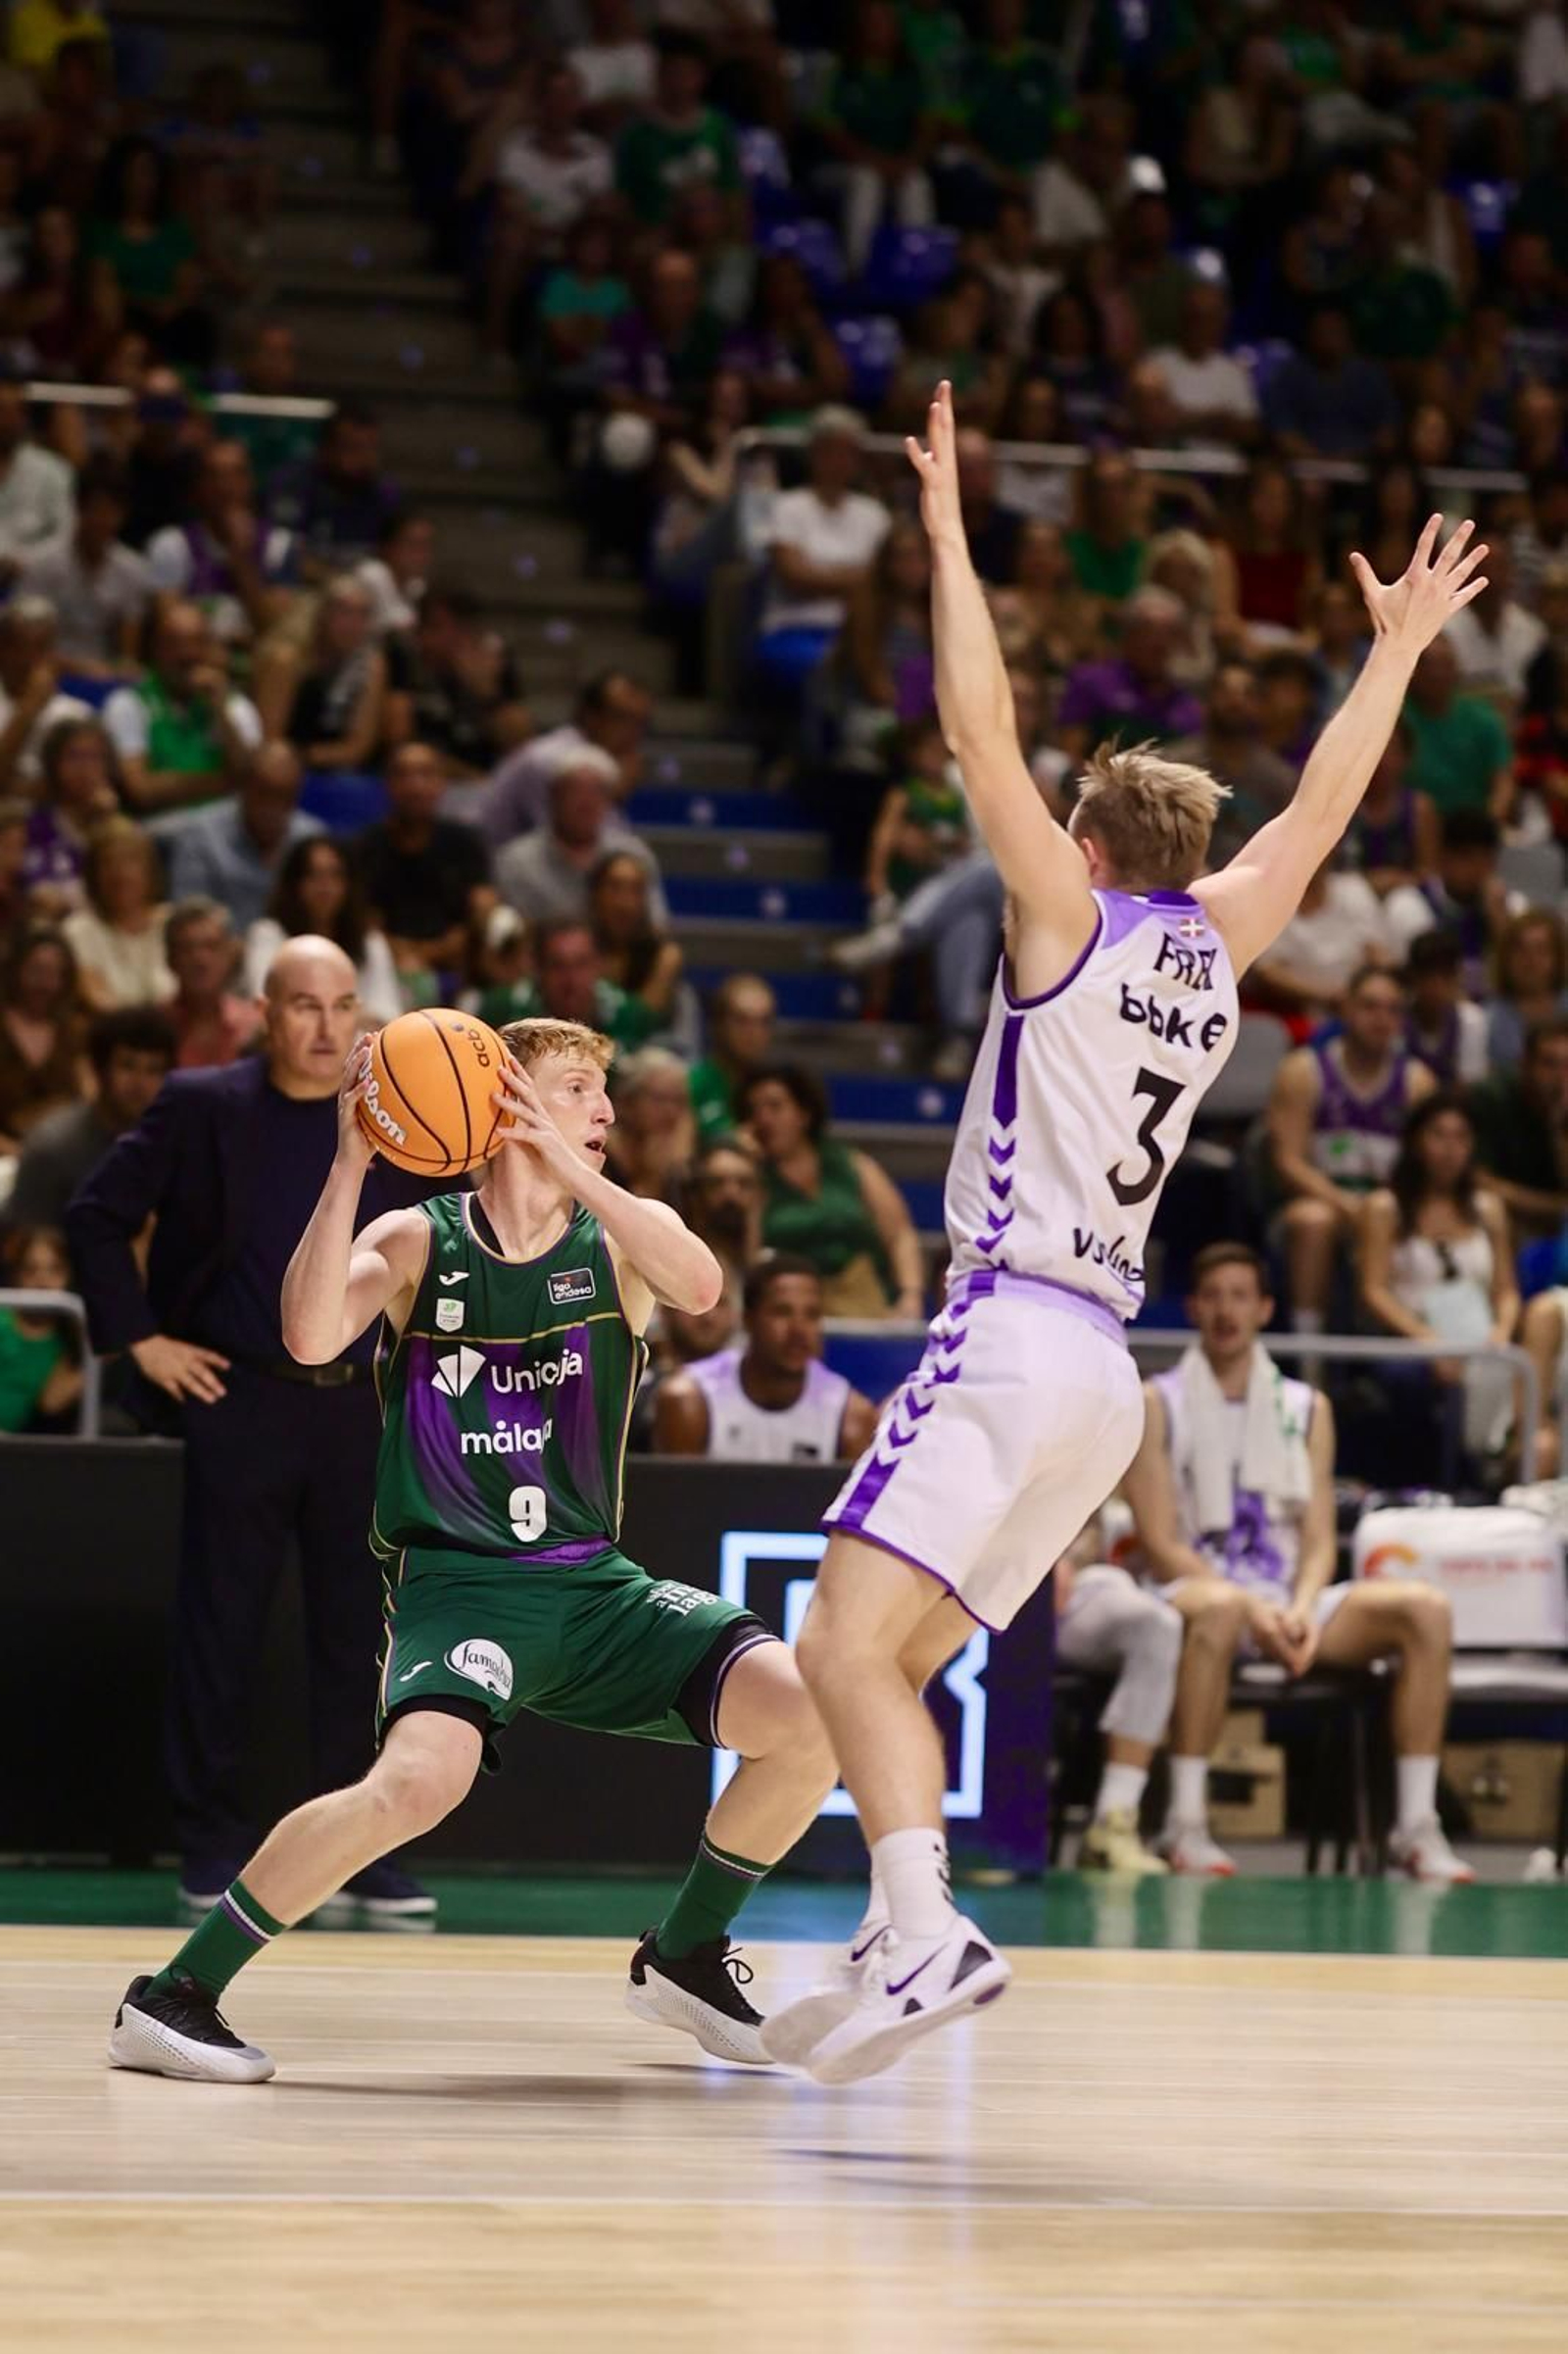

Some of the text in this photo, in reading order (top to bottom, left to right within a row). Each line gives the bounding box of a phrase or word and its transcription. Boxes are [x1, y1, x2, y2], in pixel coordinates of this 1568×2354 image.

[1105, 1066, 1187, 1205] 3
[491, 1349, 583, 1394] Unicja
[509, 1485, 547, 1543] 9
